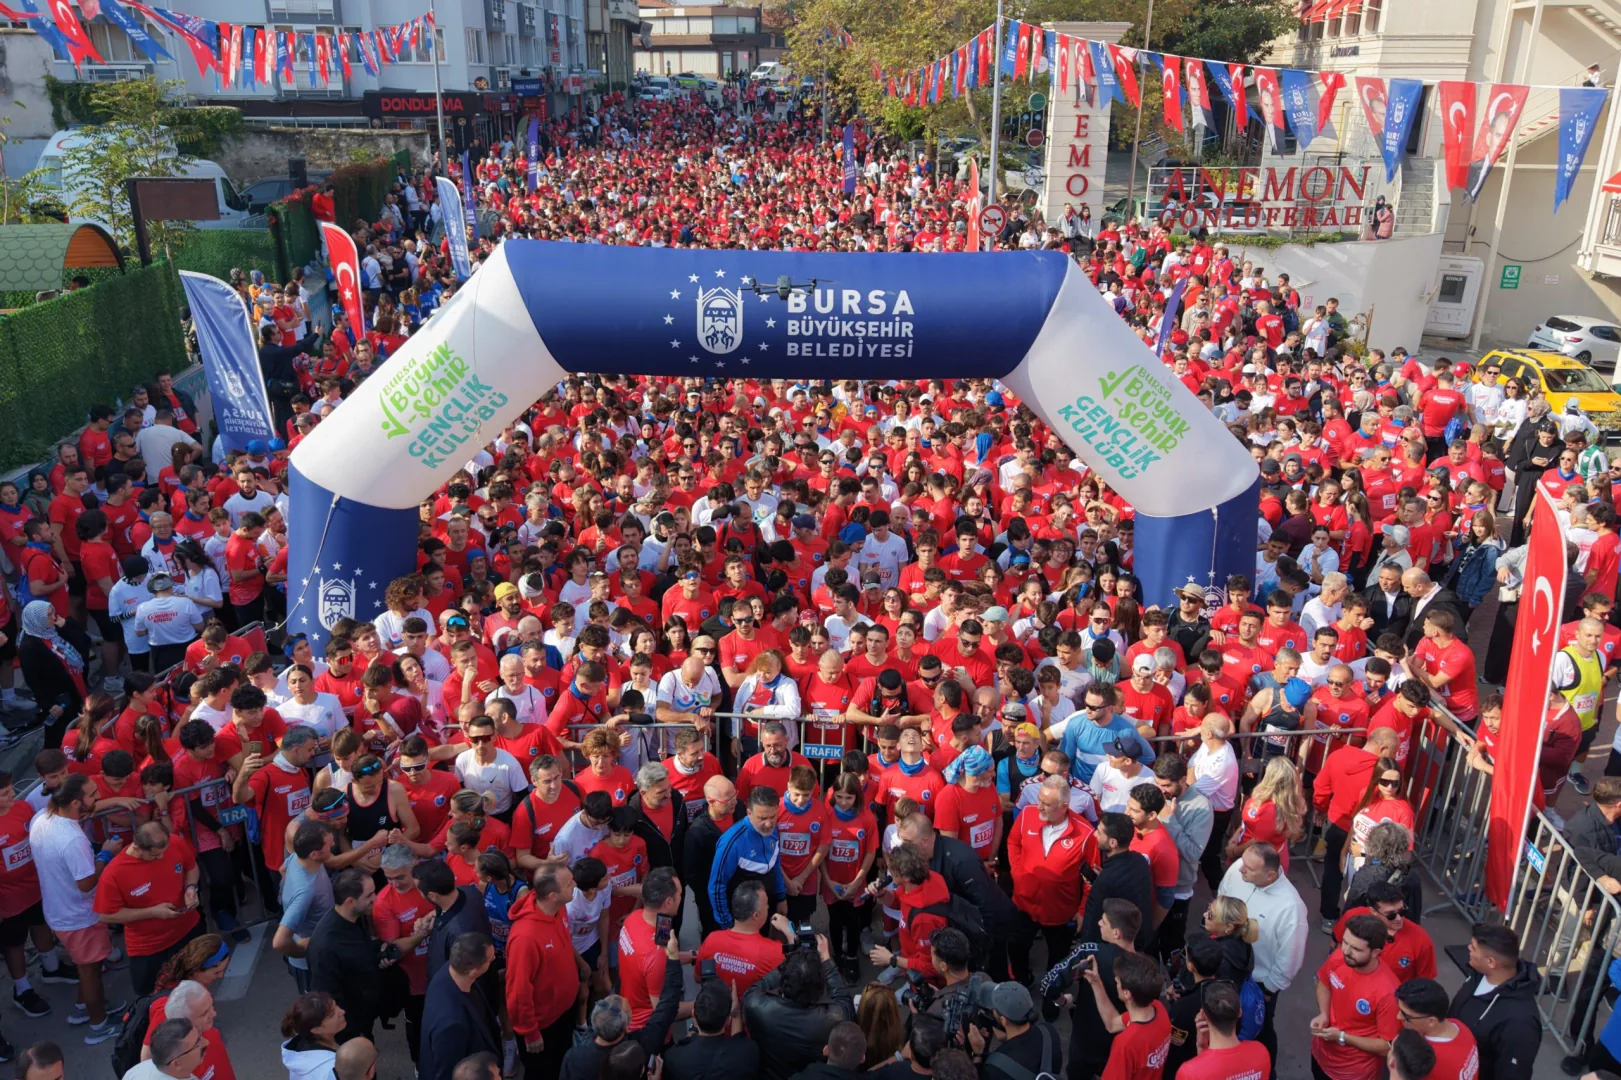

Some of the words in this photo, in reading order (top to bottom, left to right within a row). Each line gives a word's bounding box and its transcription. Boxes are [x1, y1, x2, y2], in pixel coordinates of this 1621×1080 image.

[1160, 166, 1371, 205] ANEMON
[1159, 203, 1365, 229] GÖNLÜFERAH
[787, 289, 914, 315] BURSA
[787, 316, 914, 339] BÜYÜKŞEHİR
[787, 339, 914, 358] BELEDİYESİ
[408, 373, 493, 457] GENÇLİK
[421, 391, 509, 469] KULÜBÜ
[1057, 404, 1140, 480] KULÜBÜ
[1076, 396, 1161, 472] GENÇLİK
[805, 746, 841, 758] TRAFİK
[222, 808, 248, 823] TRA
[784, 841, 805, 851] 1799
[835, 848, 850, 857] 175
[1527, 847, 1544, 872] AFİK
[714, 952, 755, 970] CUMHURİYET
[721, 963, 747, 975] KOŞUSU
